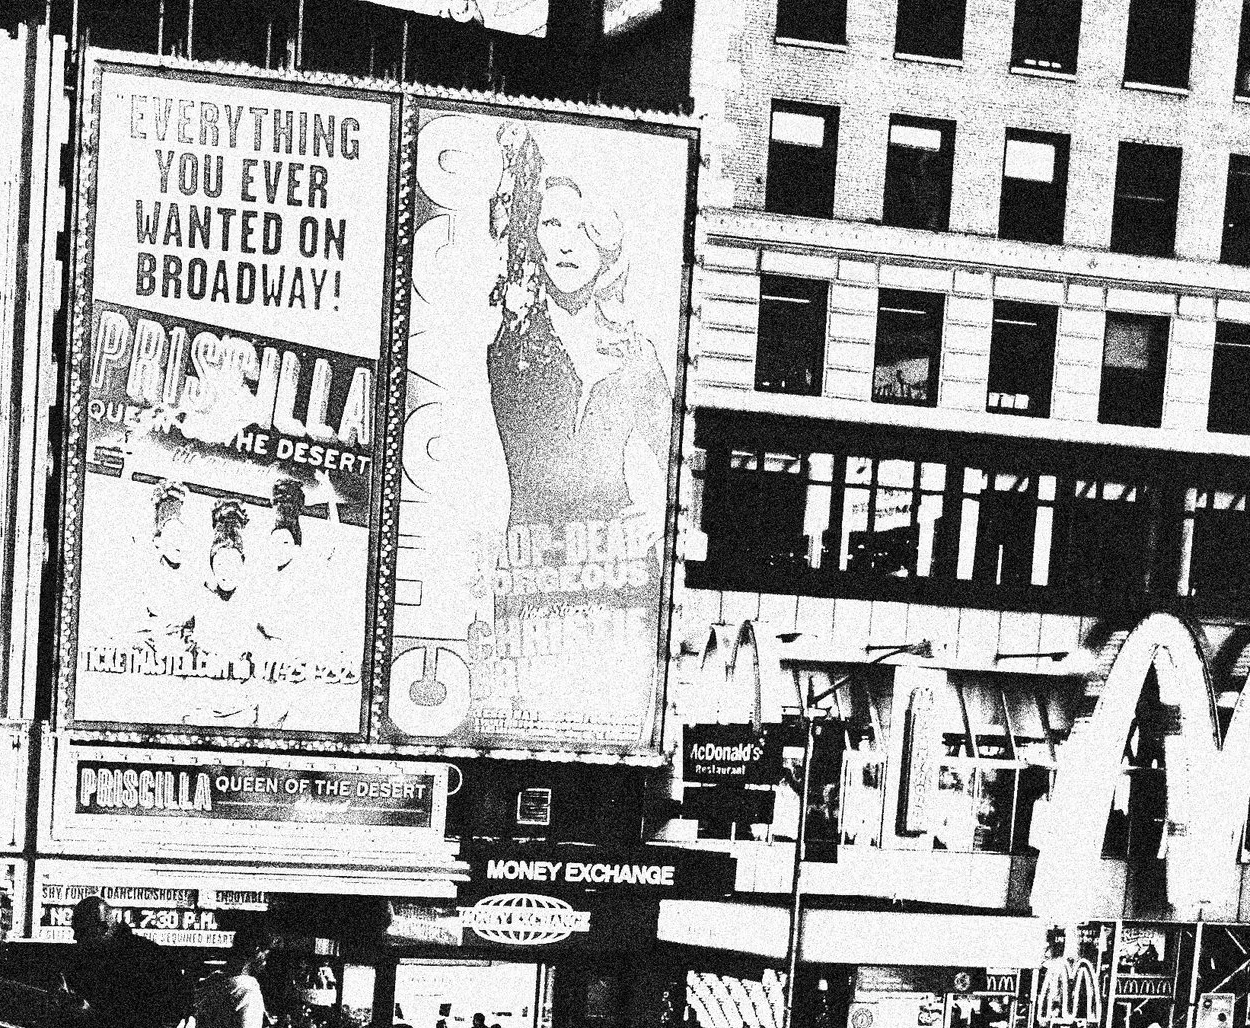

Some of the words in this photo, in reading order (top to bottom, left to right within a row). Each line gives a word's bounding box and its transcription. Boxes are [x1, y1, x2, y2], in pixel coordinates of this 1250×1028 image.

[155, 149, 224, 199] YOU
[241, 158, 328, 209] EVER
[136, 200, 283, 257] WANTED
[299, 216, 346, 262] ON
[136, 251, 342, 312] BROADWAY!
[273, 437, 372, 478] DESERT
[690, 742, 764, 762] McDonald's
[80, 767, 213, 812] PRISCILLA
[215, 776, 279, 795] QUEEN
[287, 778, 312, 795] OF
[316, 780, 350, 798] THE
[356, 781, 428, 801] DESERT
[486, 859, 560, 883] MONEY
[564, 862, 676, 887] EXCHANGE
[140, 909, 179, 929] 7:30
